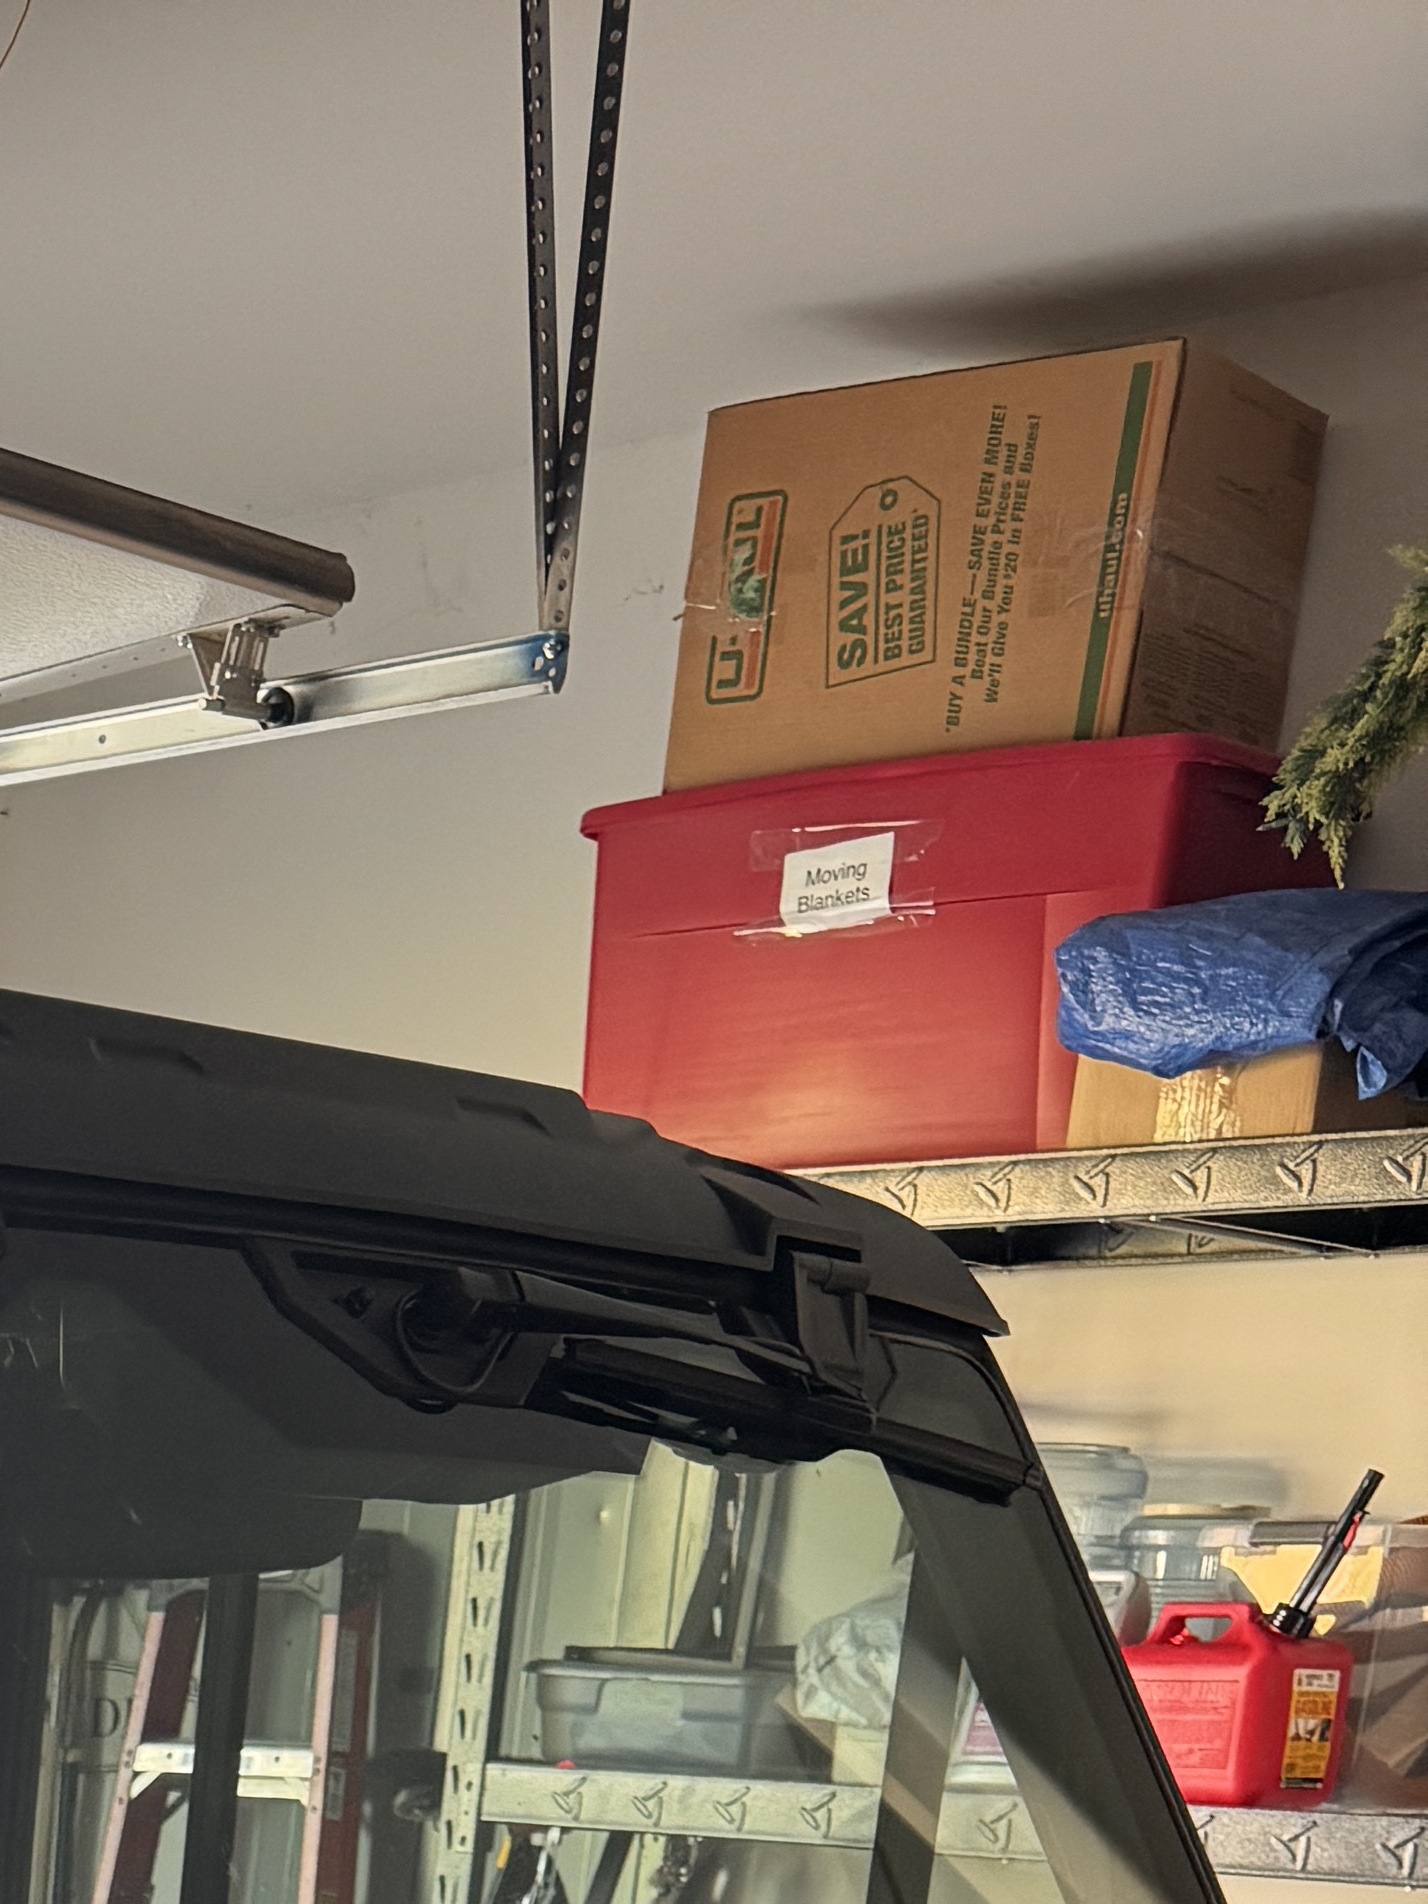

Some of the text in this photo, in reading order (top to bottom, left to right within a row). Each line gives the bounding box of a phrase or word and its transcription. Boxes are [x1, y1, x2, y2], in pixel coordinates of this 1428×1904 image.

[983, 403, 1008, 466] MORE!
[1018, 413, 1042, 474] Boxes!
[975, 471, 995, 519] EVEN
[1009, 478, 1031, 523] FREE
[970, 442, 1019, 680] Beat Our Bundle Prices and
[1097, 492, 1129, 619] uhaul.com
[715, 504, 764, 690] U-AUL
[836, 528, 871, 670] SAVE!
[882, 520, 906, 662] BEST PRICE
[996, 585, 1014, 616] You
[990, 621, 1009, 658] Give
[950, 674, 966, 687] A
[983, 662, 1003, 704] We'll
[804, 861, 868, 888] Moving
[796, 885, 871, 915] Blankets
